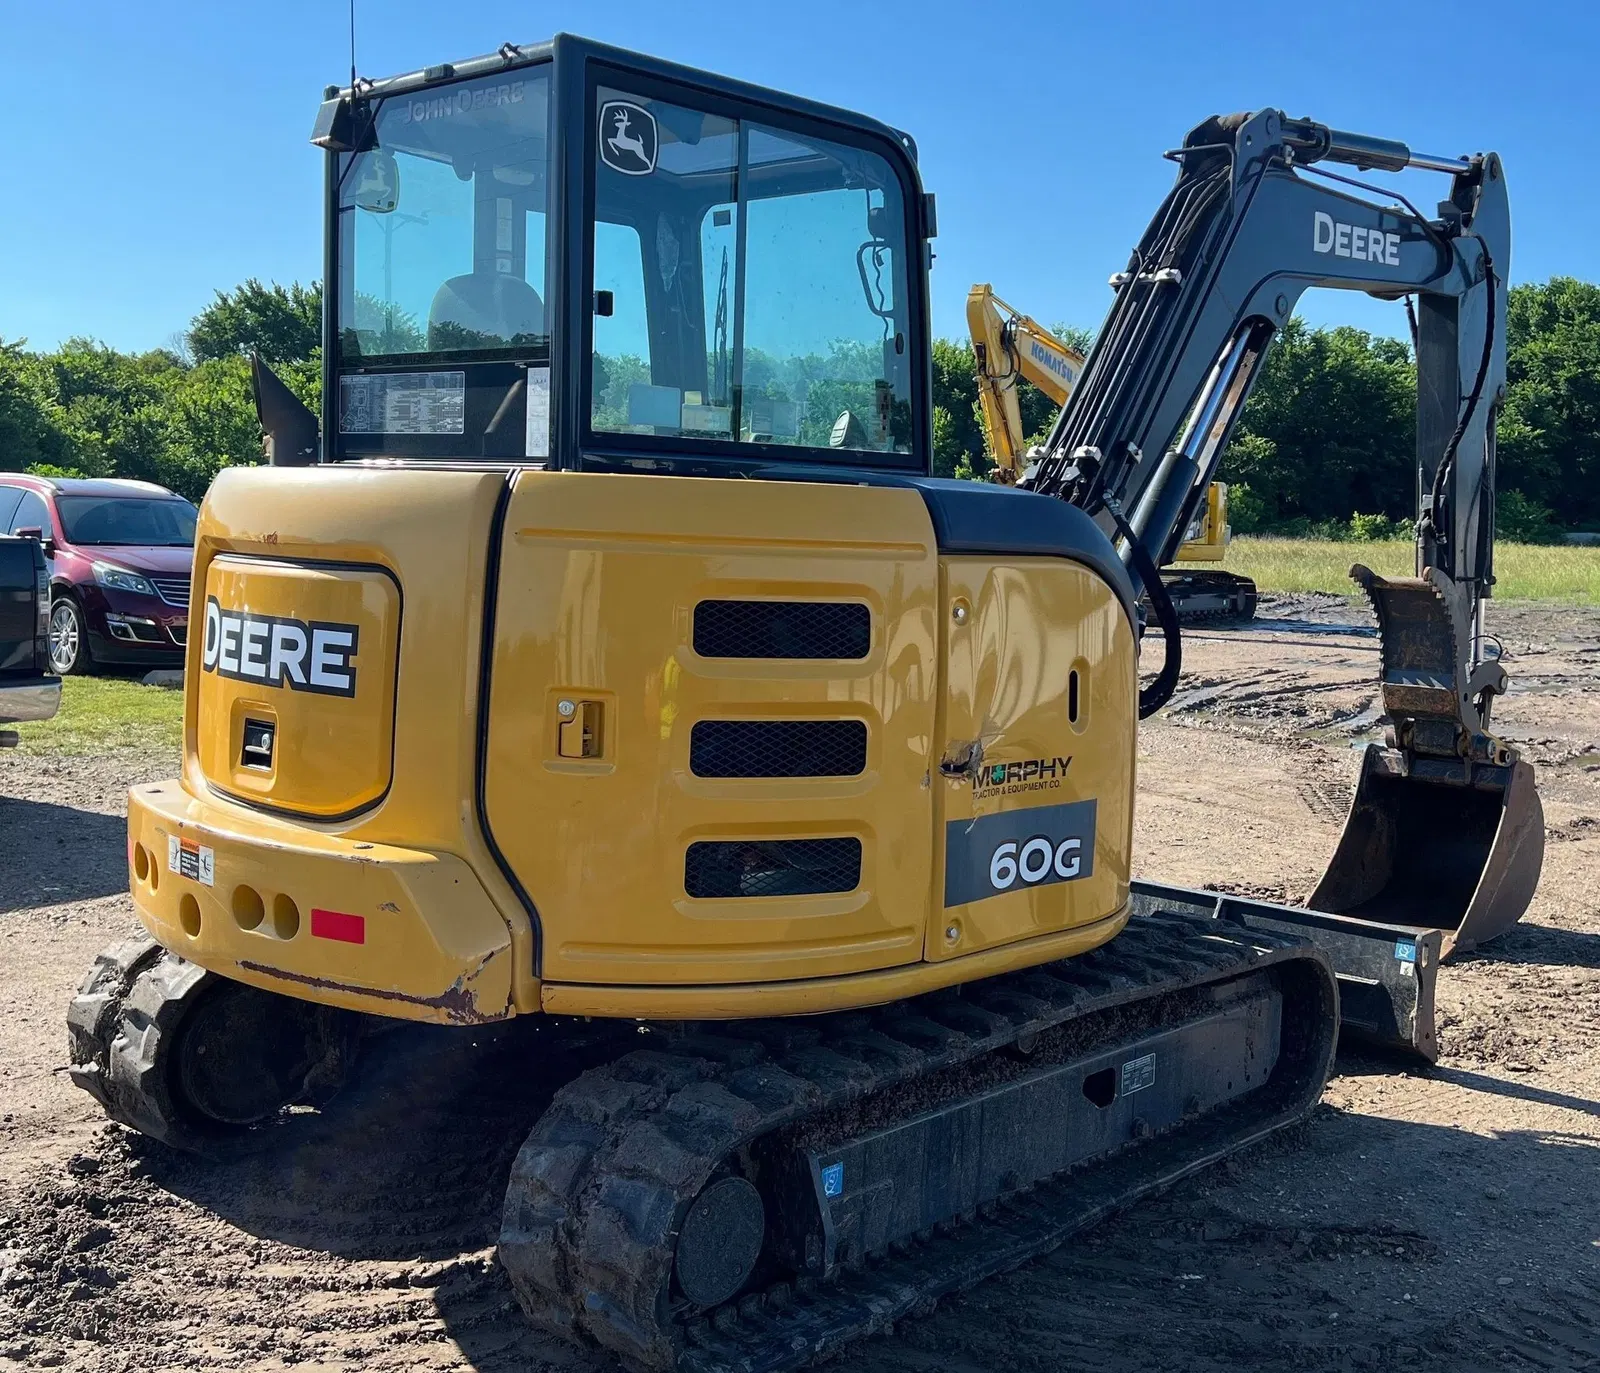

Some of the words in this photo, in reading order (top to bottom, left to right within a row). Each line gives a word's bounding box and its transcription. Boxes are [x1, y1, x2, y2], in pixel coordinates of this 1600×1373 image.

[404, 97, 454, 124] JOHN
[457, 82, 524, 113] DEERE
[1313, 210, 1401, 267] DEERE
[1031, 340, 1073, 384] KOMATSU
[203, 601, 354, 690] DEERE
[972, 756, 1073, 790] MURPHY
[1001, 786, 1007, 795] &
[1007, 780, 1048, 795] EQUIPMENT
[1049, 779, 1061, 789] CO.
[989, 838, 1081, 889] 60G
